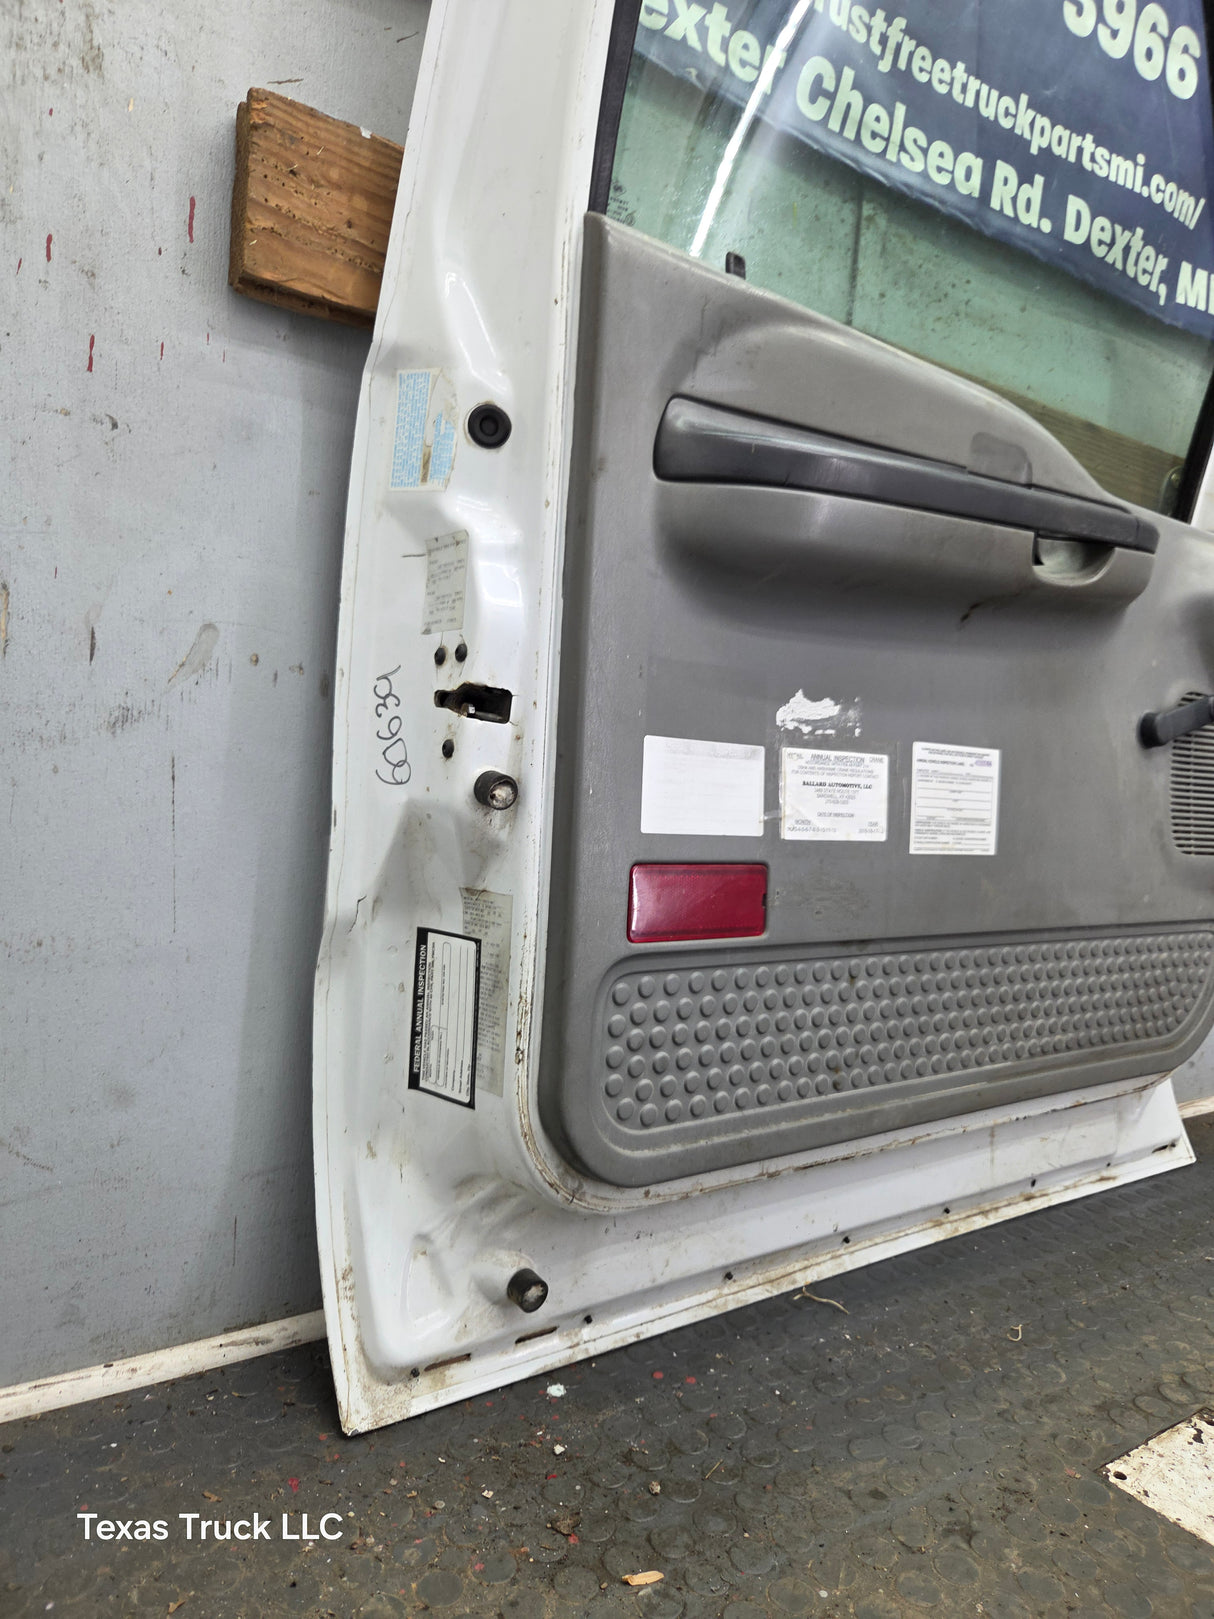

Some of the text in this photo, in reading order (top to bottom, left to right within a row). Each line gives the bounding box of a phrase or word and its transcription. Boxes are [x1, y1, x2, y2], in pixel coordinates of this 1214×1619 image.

[795, 56, 984, 199] Chelsea
[990, 160, 1051, 234] Rd.
[1063, 194, 1169, 306] Dexter,
[811, 753, 832, 762] ANNUAL
[834, 755, 865, 764] INSPECTION
[828, 782, 862, 790] AUTOMOTIVE,
[413, 943, 426, 1073] FEDERAL ANNUAL INSPECTION
